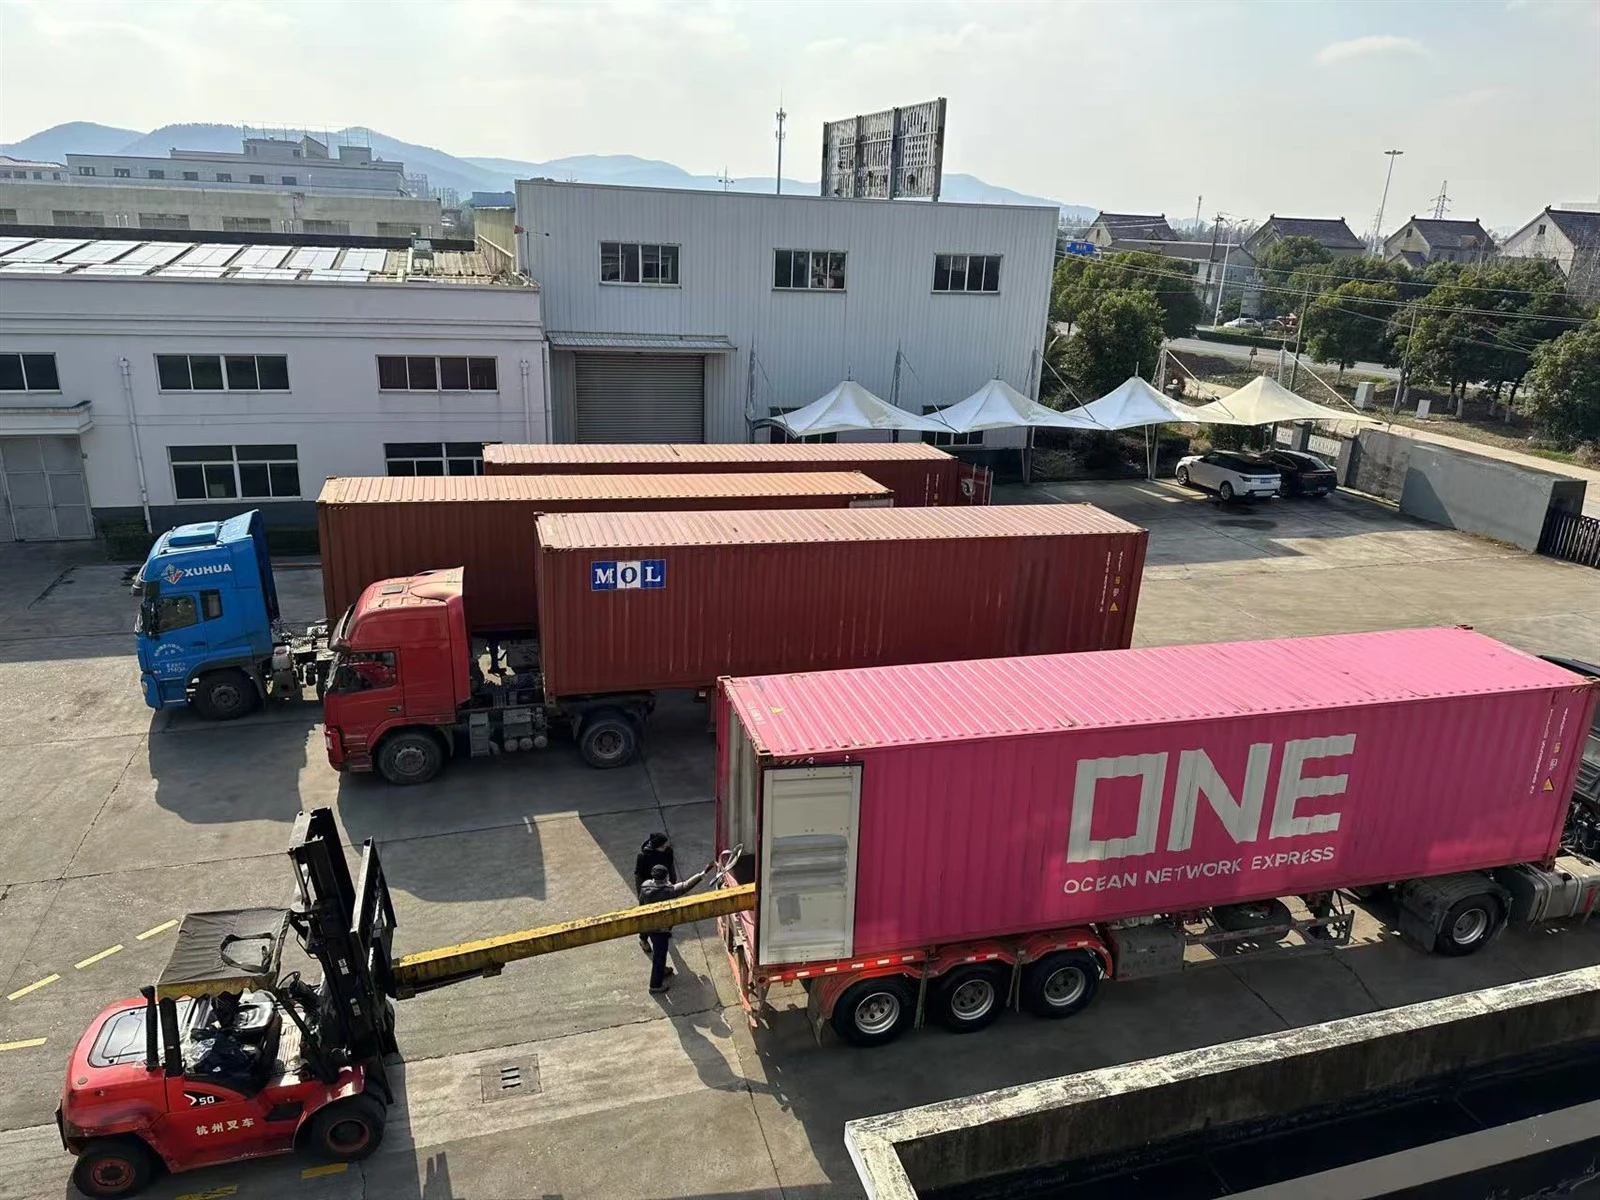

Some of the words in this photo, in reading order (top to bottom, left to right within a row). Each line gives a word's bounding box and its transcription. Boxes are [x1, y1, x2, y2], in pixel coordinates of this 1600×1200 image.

[184, 563, 232, 577] XUHUA
[595, 566, 661, 584] MOL
[1066, 733, 1357, 863] ONE
[1064, 872, 1138, 894] OCEAN
[1145, 858, 1241, 885] NETWORK
[1251, 846, 1334, 871] EXPRESS
[196, 1118, 255, 1136] 杭州叉车
